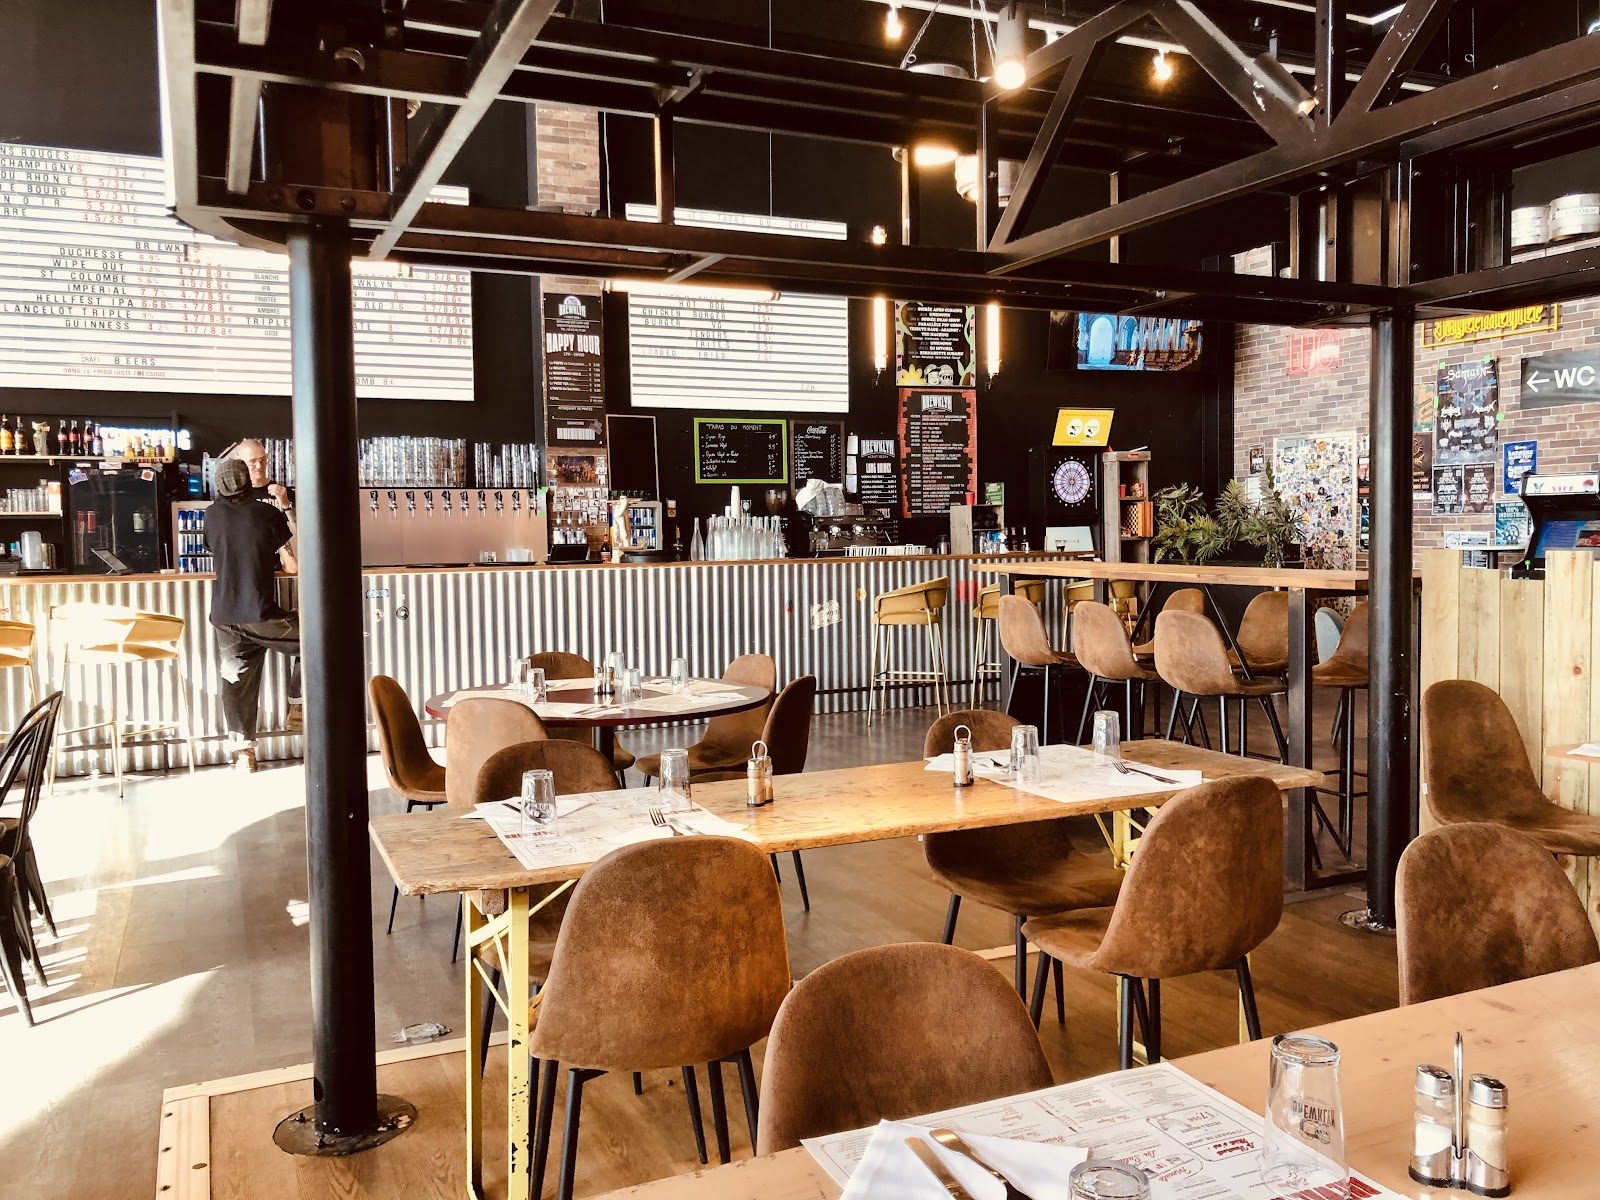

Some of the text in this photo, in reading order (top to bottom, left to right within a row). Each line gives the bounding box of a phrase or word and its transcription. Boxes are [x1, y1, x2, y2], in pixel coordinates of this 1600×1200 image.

[21, 148, 70, 160] ROUGES
[0, 159, 74, 172] CHAMPIGNY
[27, 172, 72, 184] RHONE
[27, 184, 67, 197] BOURG
[4, 196, 60, 207] NOIR
[60, 247, 123, 260] DUCHESSE
[53, 259, 85, 269] WIPE
[102, 262, 124, 271] OUT
[41, 269, 54, 278] ST
[71, 272, 126, 283] COLOMBE
[254, 273, 279, 281] BLANCHE
[68, 284, 127, 295] IMPERIAL
[37, 294, 101, 305] HELLFEST
[112, 298, 134, 307] IPA
[4, 303, 73, 315] LANCELOT
[82, 307, 131, 319] TRIPLE
[642, 308, 681, 317] CHICKEN
[692, 311, 726, 320] BURGER
[65, 319, 130, 330] GUINNESS
[246, 316, 289, 327] TRIPLE
[644, 318, 681, 327] BURGER
[689, 330, 728, 339] TENDERS
[546, 332, 600, 356] HAPPY HOUR
[698, 351, 726, 359] FRIES
[114, 356, 156, 367] BEERS
[1553, 365, 1596, 389] WC
